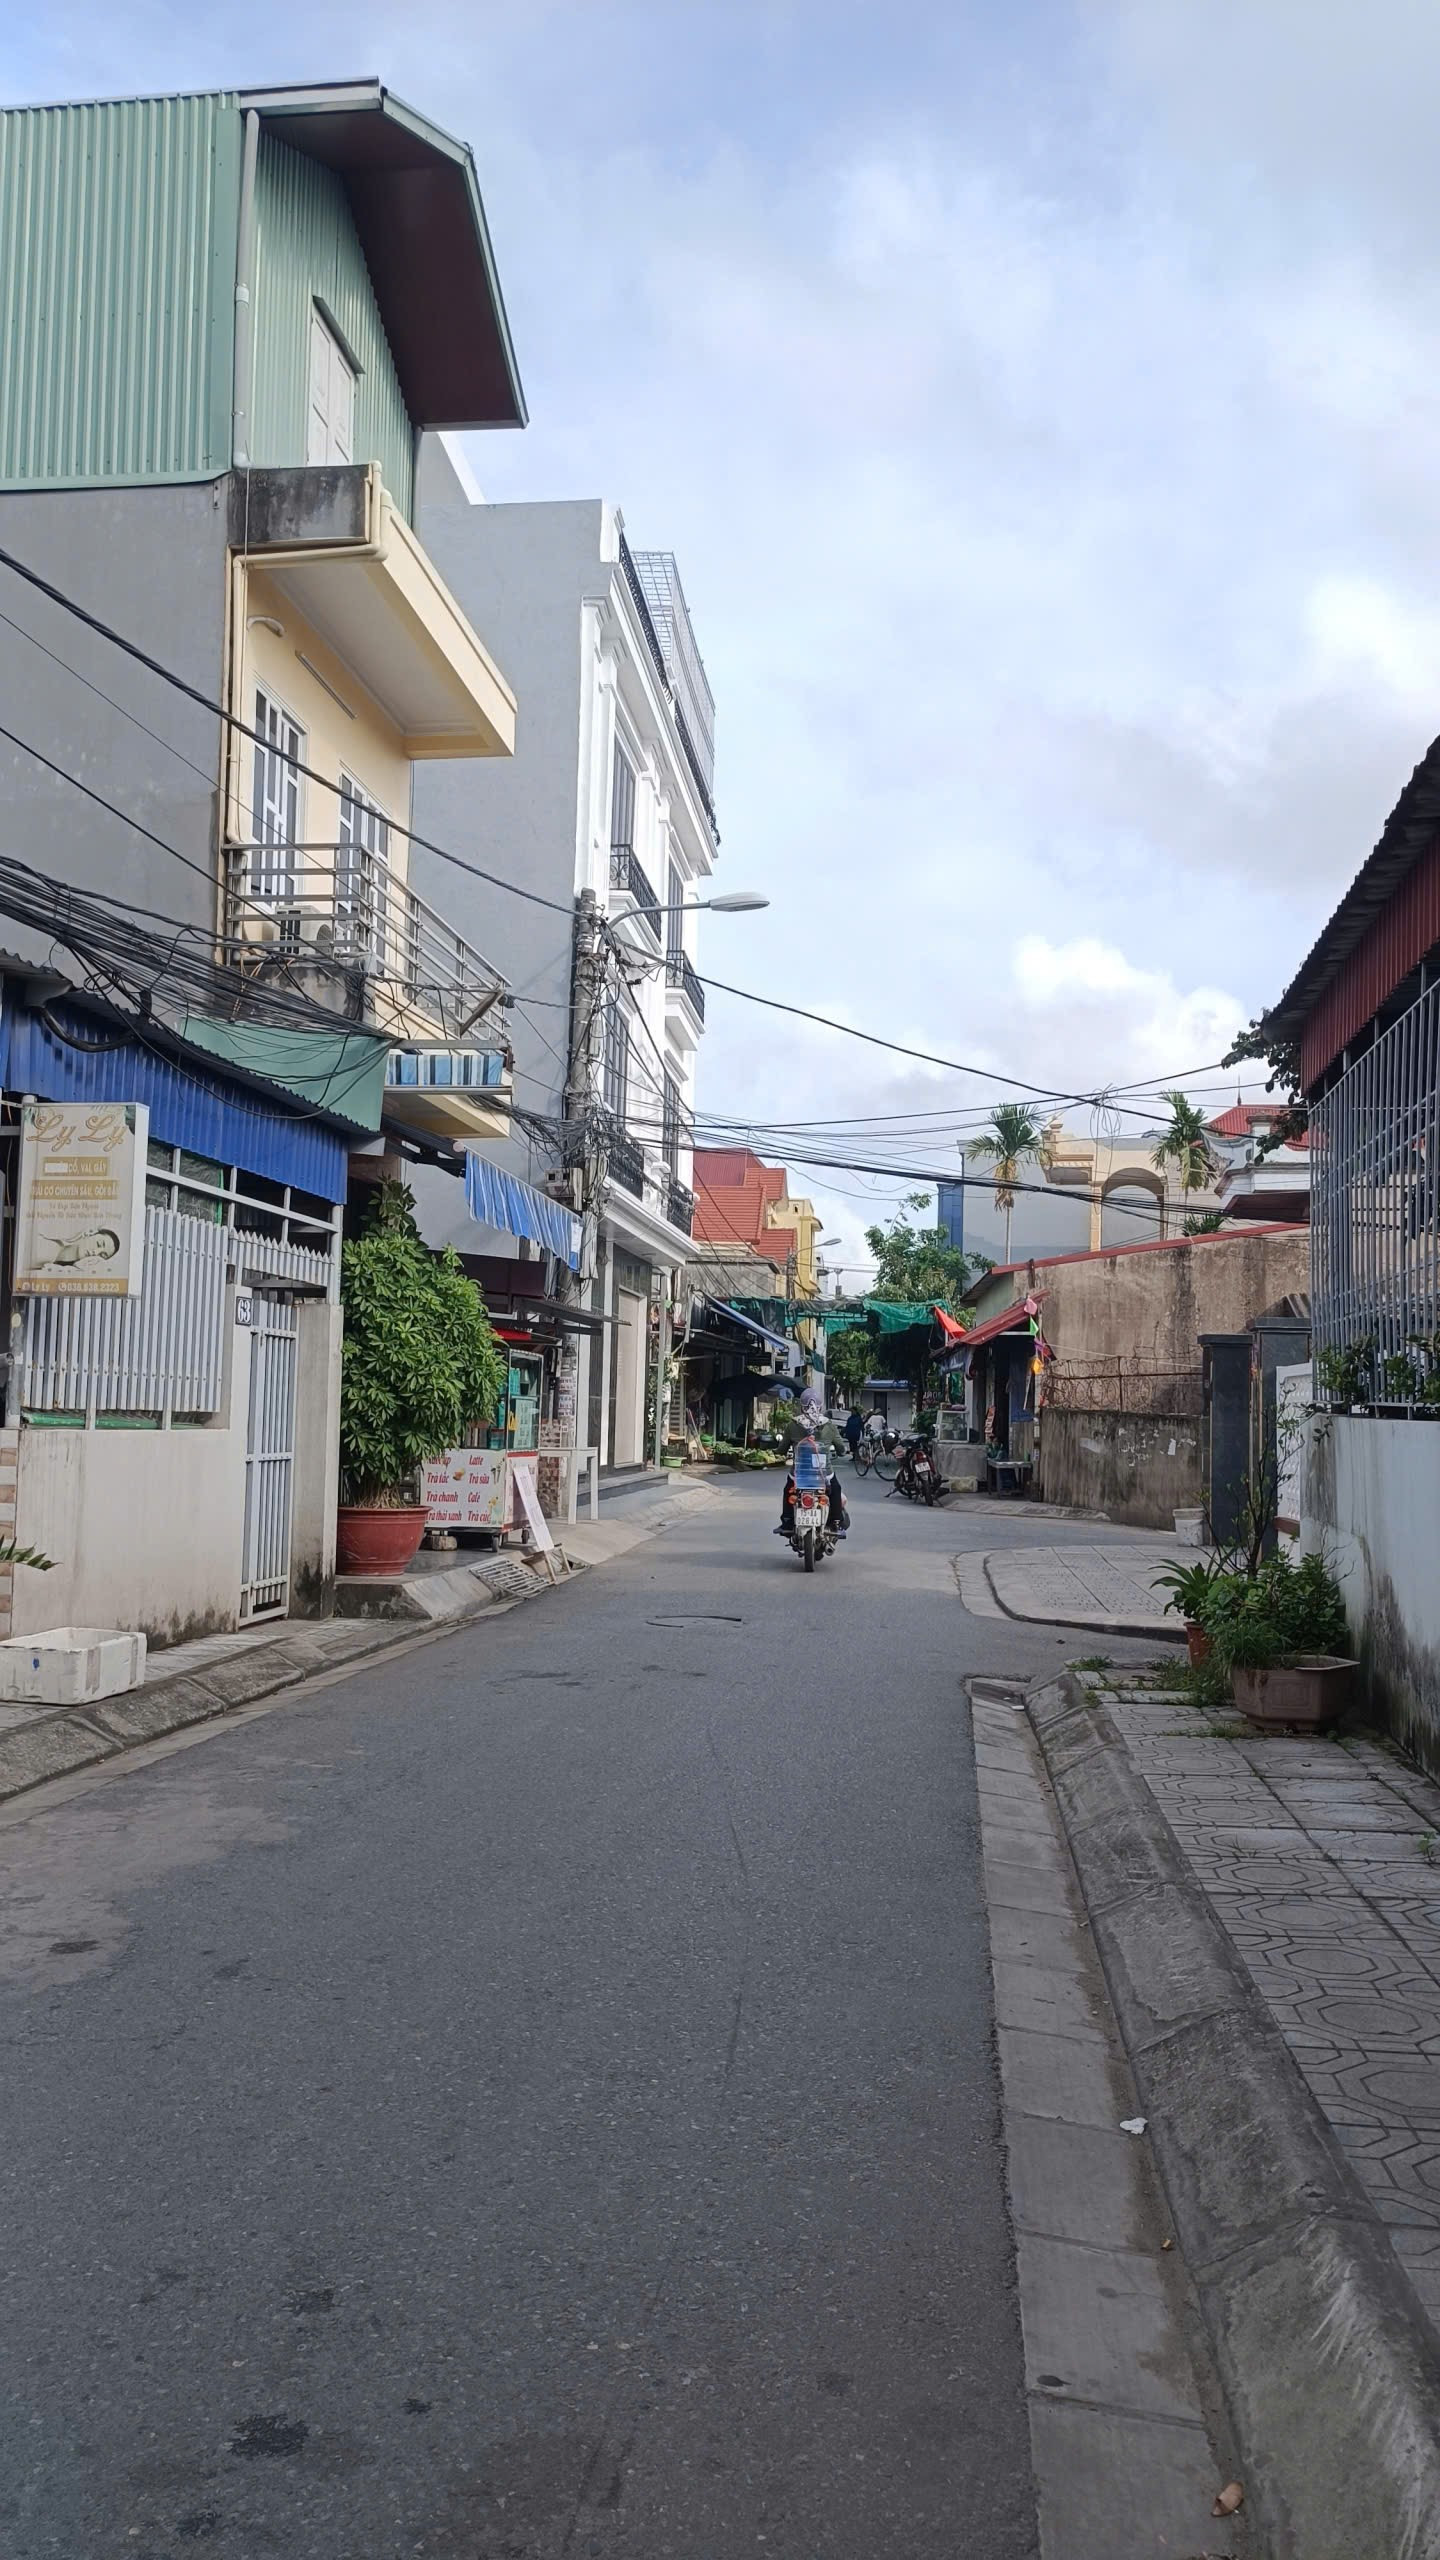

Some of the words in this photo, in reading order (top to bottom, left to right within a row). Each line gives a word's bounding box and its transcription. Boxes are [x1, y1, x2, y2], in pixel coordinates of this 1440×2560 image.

[26, 1114, 76, 1152] Ly
[78, 1114, 127, 1152] Ly
[238, 1299, 251, 1323] 63
[468, 1454, 485, 1466] Latte
[427, 1472, 438, 1484] Trà
[469, 1472, 479, 1484] Trà
[426, 1490, 438, 1503] Trà
[438, 1491, 459, 1503] chanh
[448, 1510, 463, 1521] xanh
[467, 1510, 479, 1522] Trà
